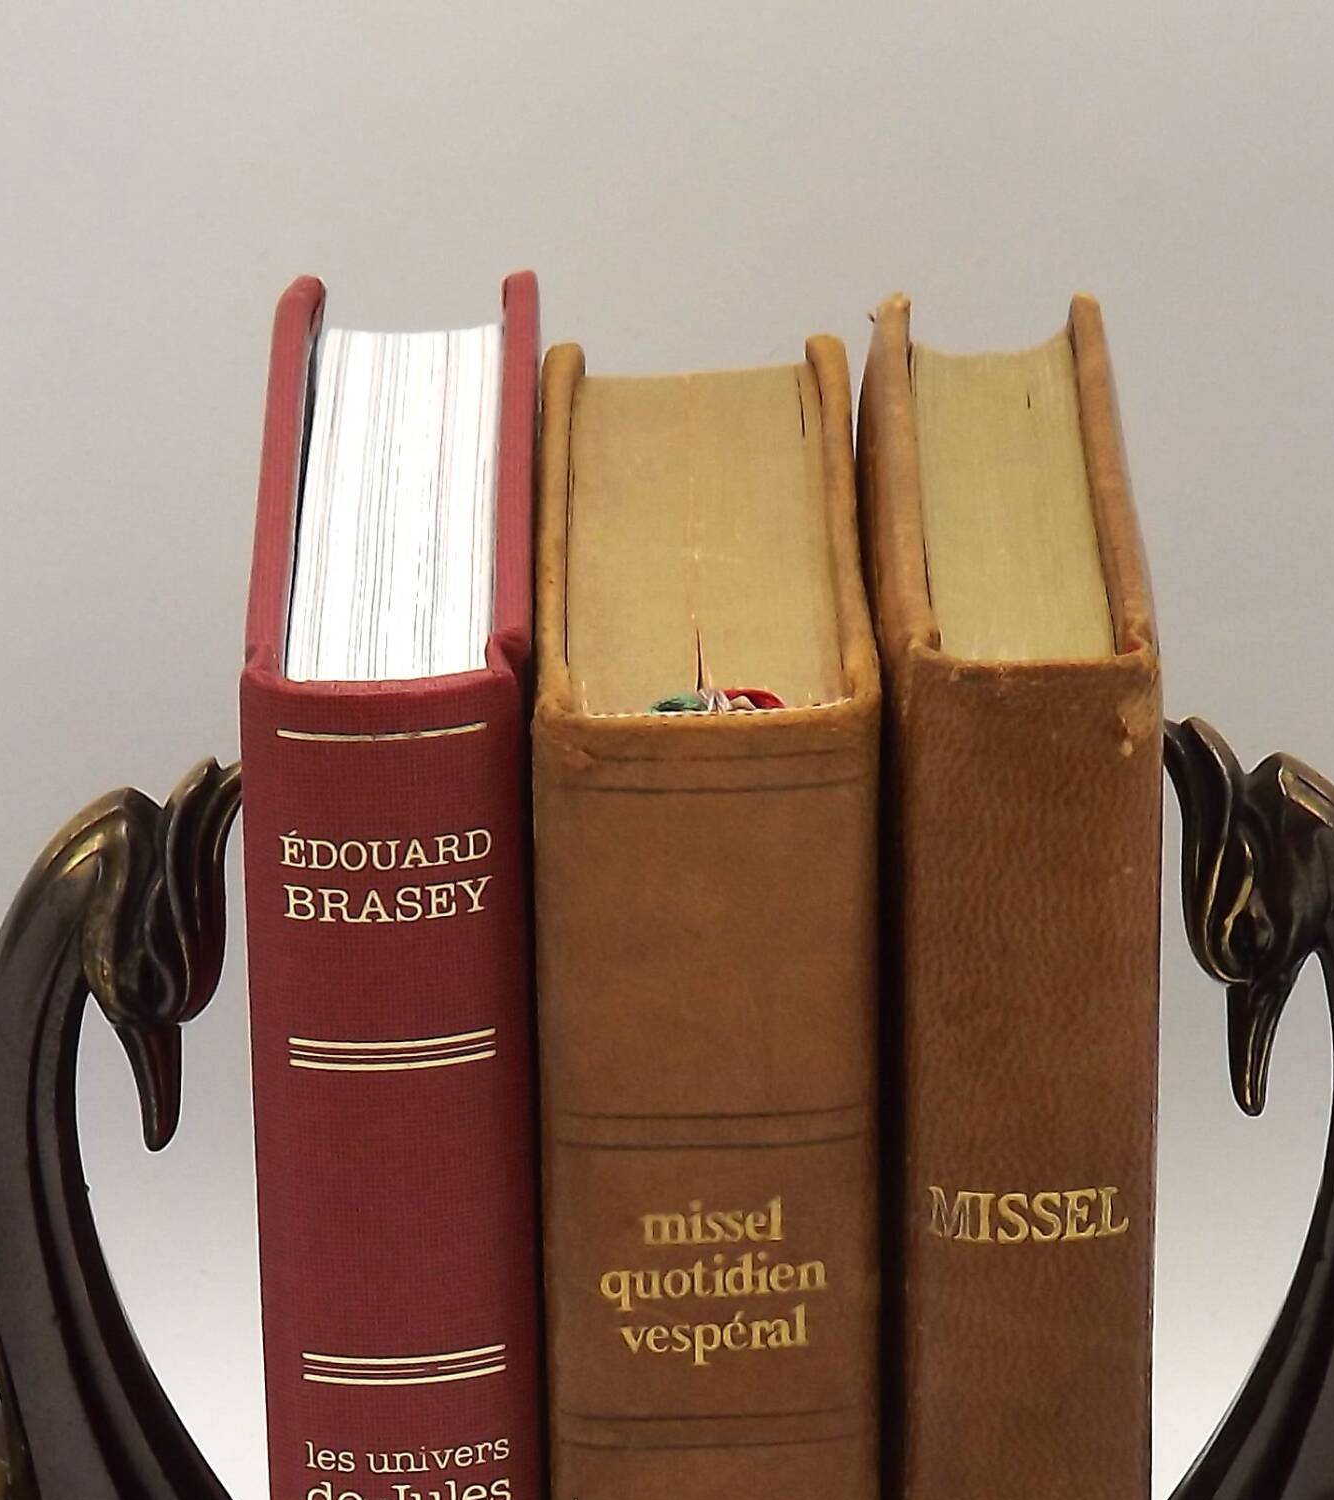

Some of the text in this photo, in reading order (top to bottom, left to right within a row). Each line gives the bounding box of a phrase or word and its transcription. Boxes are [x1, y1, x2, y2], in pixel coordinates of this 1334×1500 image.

[278, 829, 493, 871] ÉDOUARD
[283, 875, 493, 923] BRASEY
[640, 1195, 785, 1245] missel
[927, 1185, 1130, 1244] MISSEL
[599, 1251, 828, 1312] quotidien
[619, 1303, 810, 1366] vespéral
[305, 1437, 510, 1474] les univers
